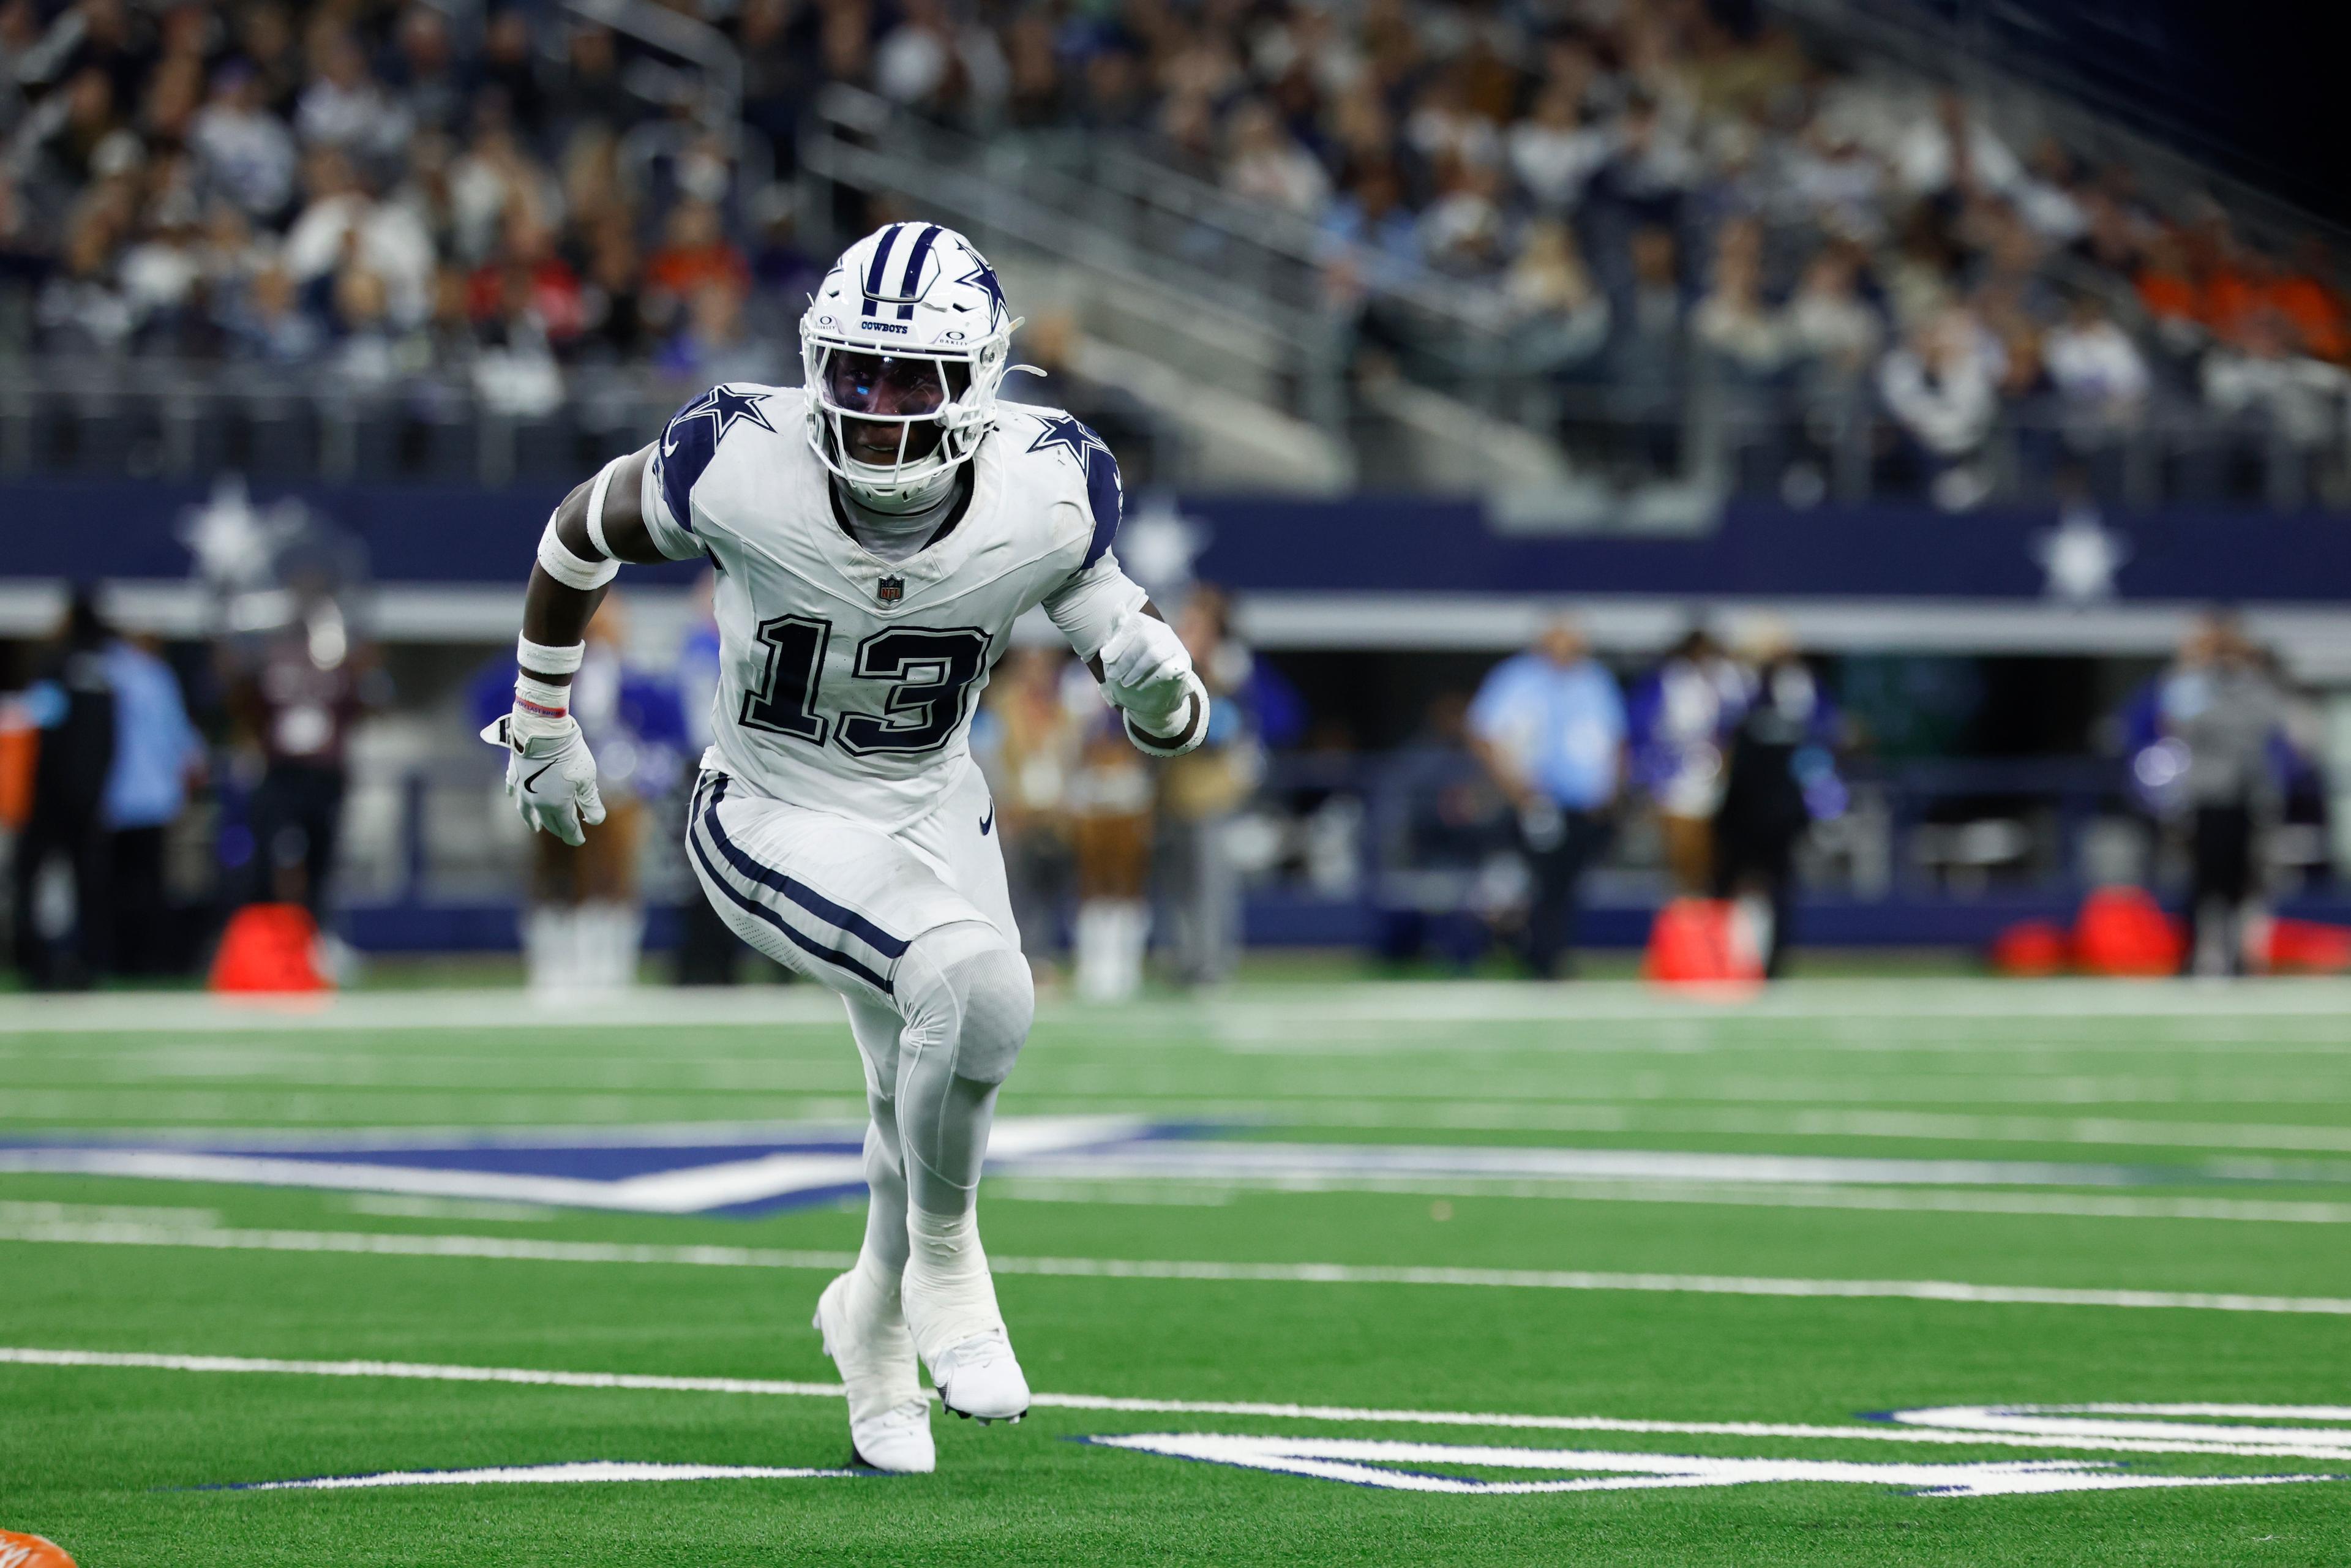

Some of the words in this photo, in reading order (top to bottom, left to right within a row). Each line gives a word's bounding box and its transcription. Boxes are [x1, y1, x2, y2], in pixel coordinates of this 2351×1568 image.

[861, 321, 908, 334] COWBOYS
[882, 588, 900, 599] NFL
[738, 613, 994, 757] 13
